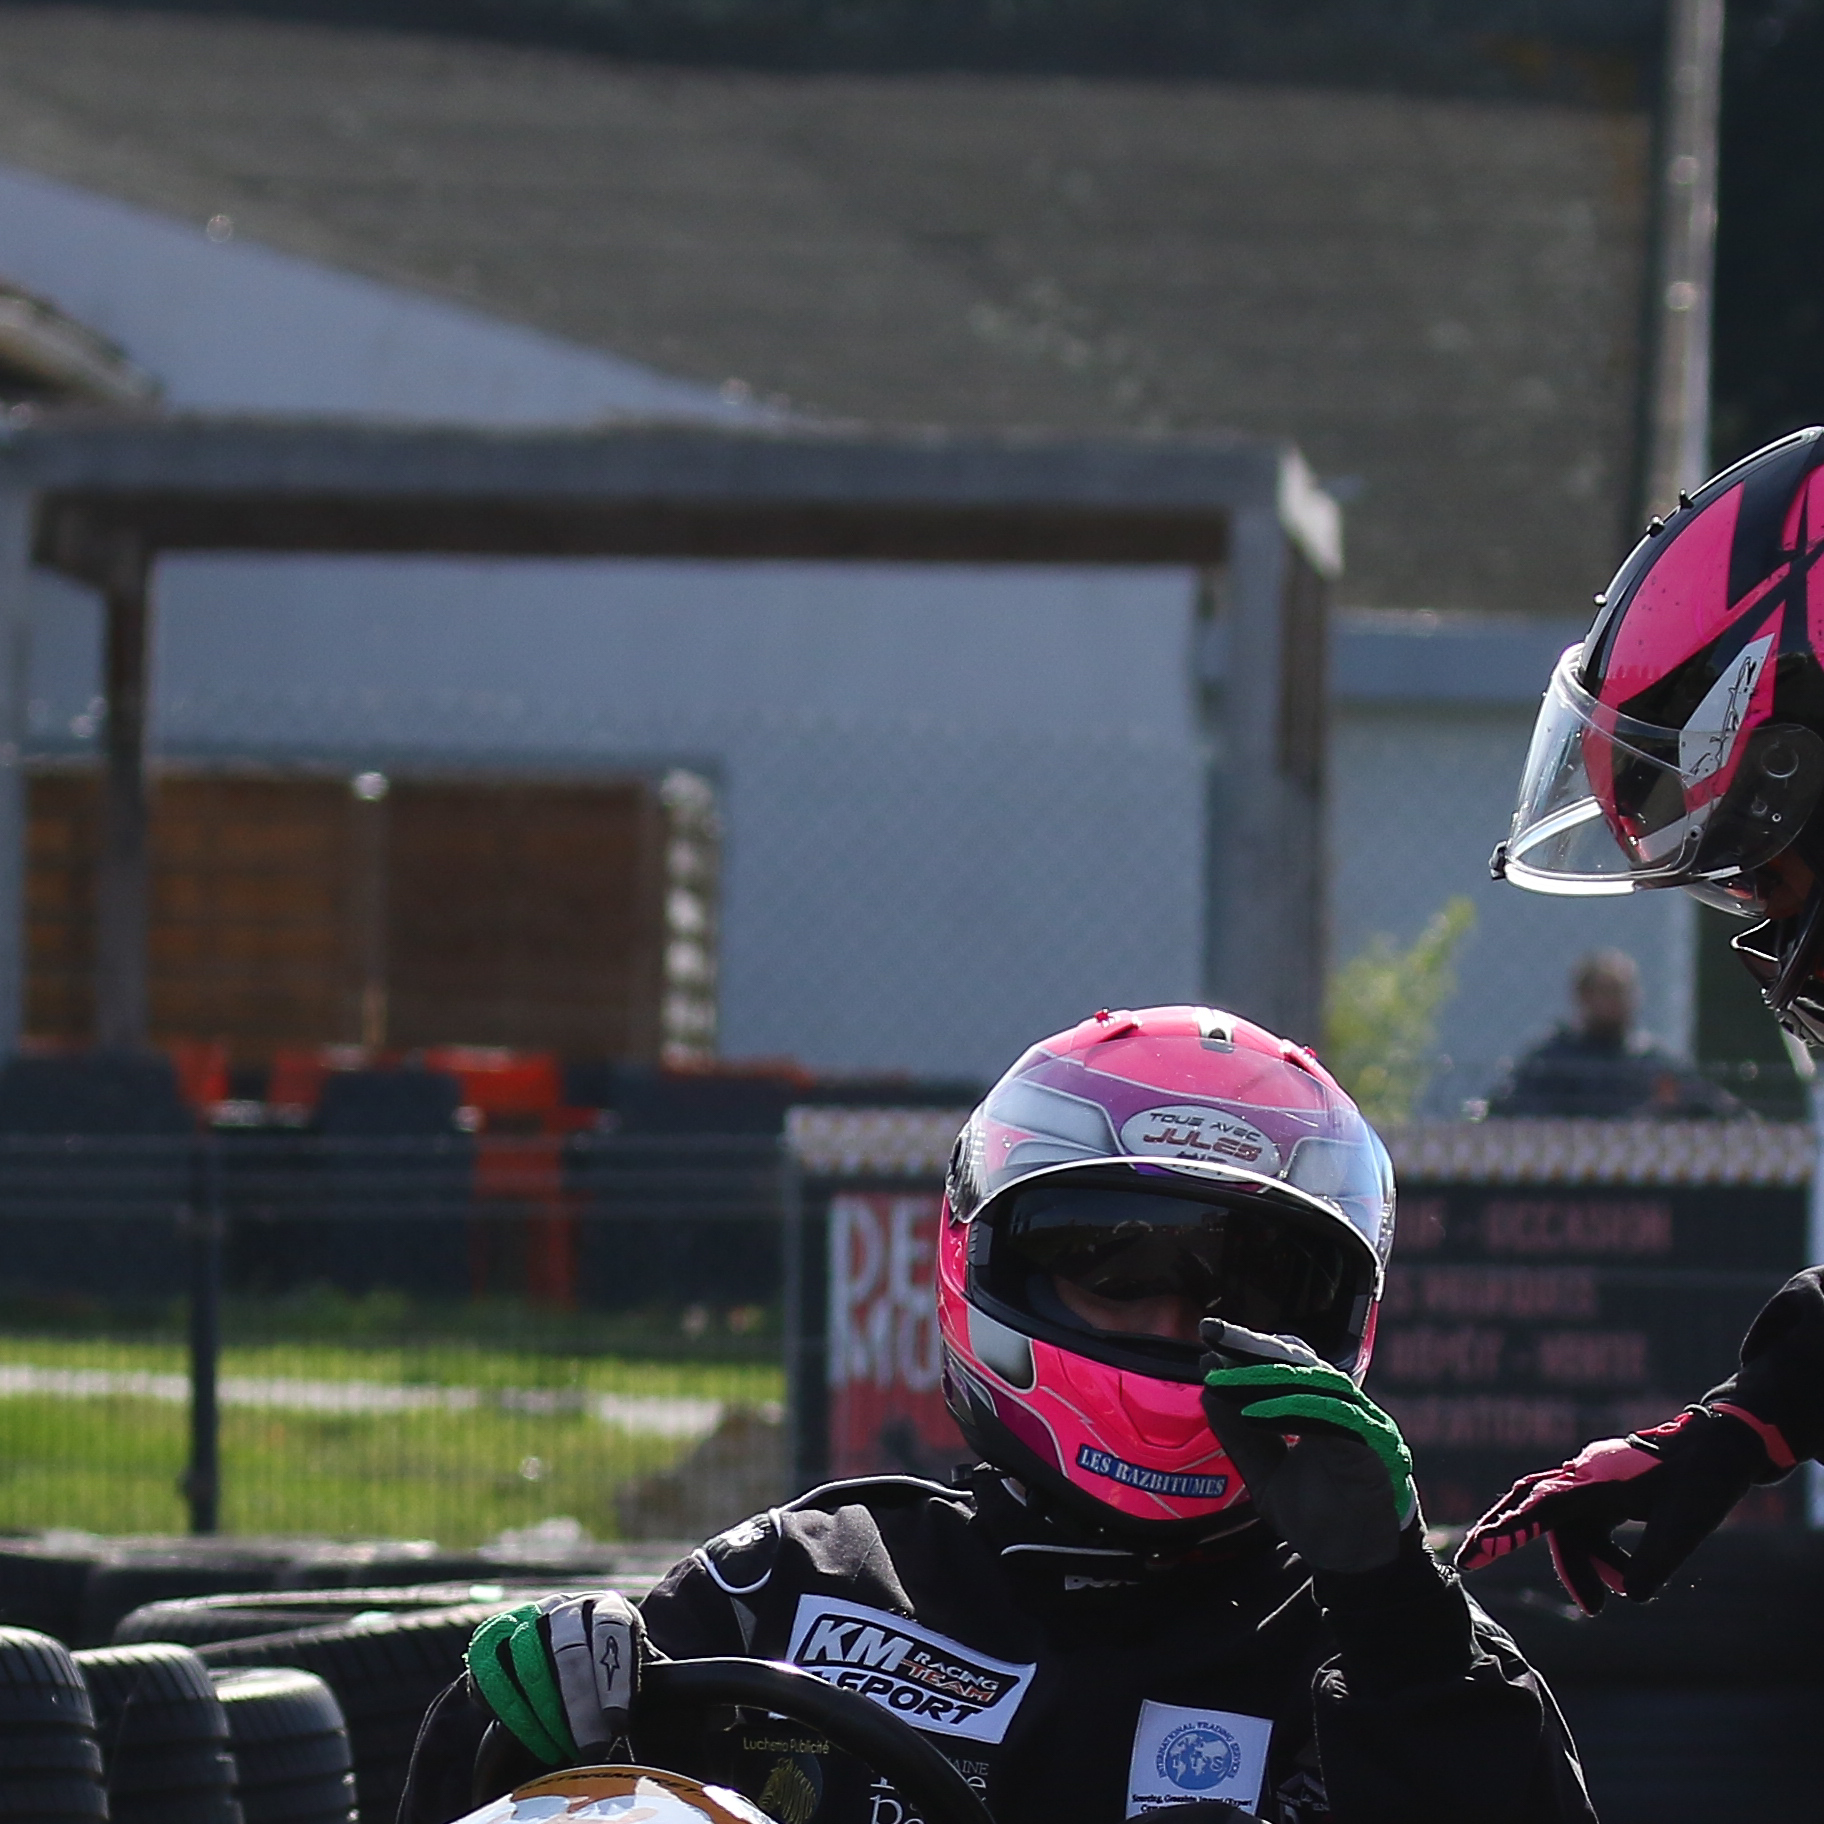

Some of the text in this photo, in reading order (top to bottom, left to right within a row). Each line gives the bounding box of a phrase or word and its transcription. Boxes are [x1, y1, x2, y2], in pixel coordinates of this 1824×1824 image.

[1142, 1127, 1263, 1163] JULES
[1150, 1112, 1262, 1143] TOUS AVEC
[1080, 1449, 1226, 1496] LES RAZBITUMES
[802, 1619, 914, 1673] KM
[900, 1658, 996, 1703] TEAM
[913, 1650, 1000, 1692] RACING
[836, 1670, 984, 1726] SPORT
[948, 1757, 990, 1776] AINE
